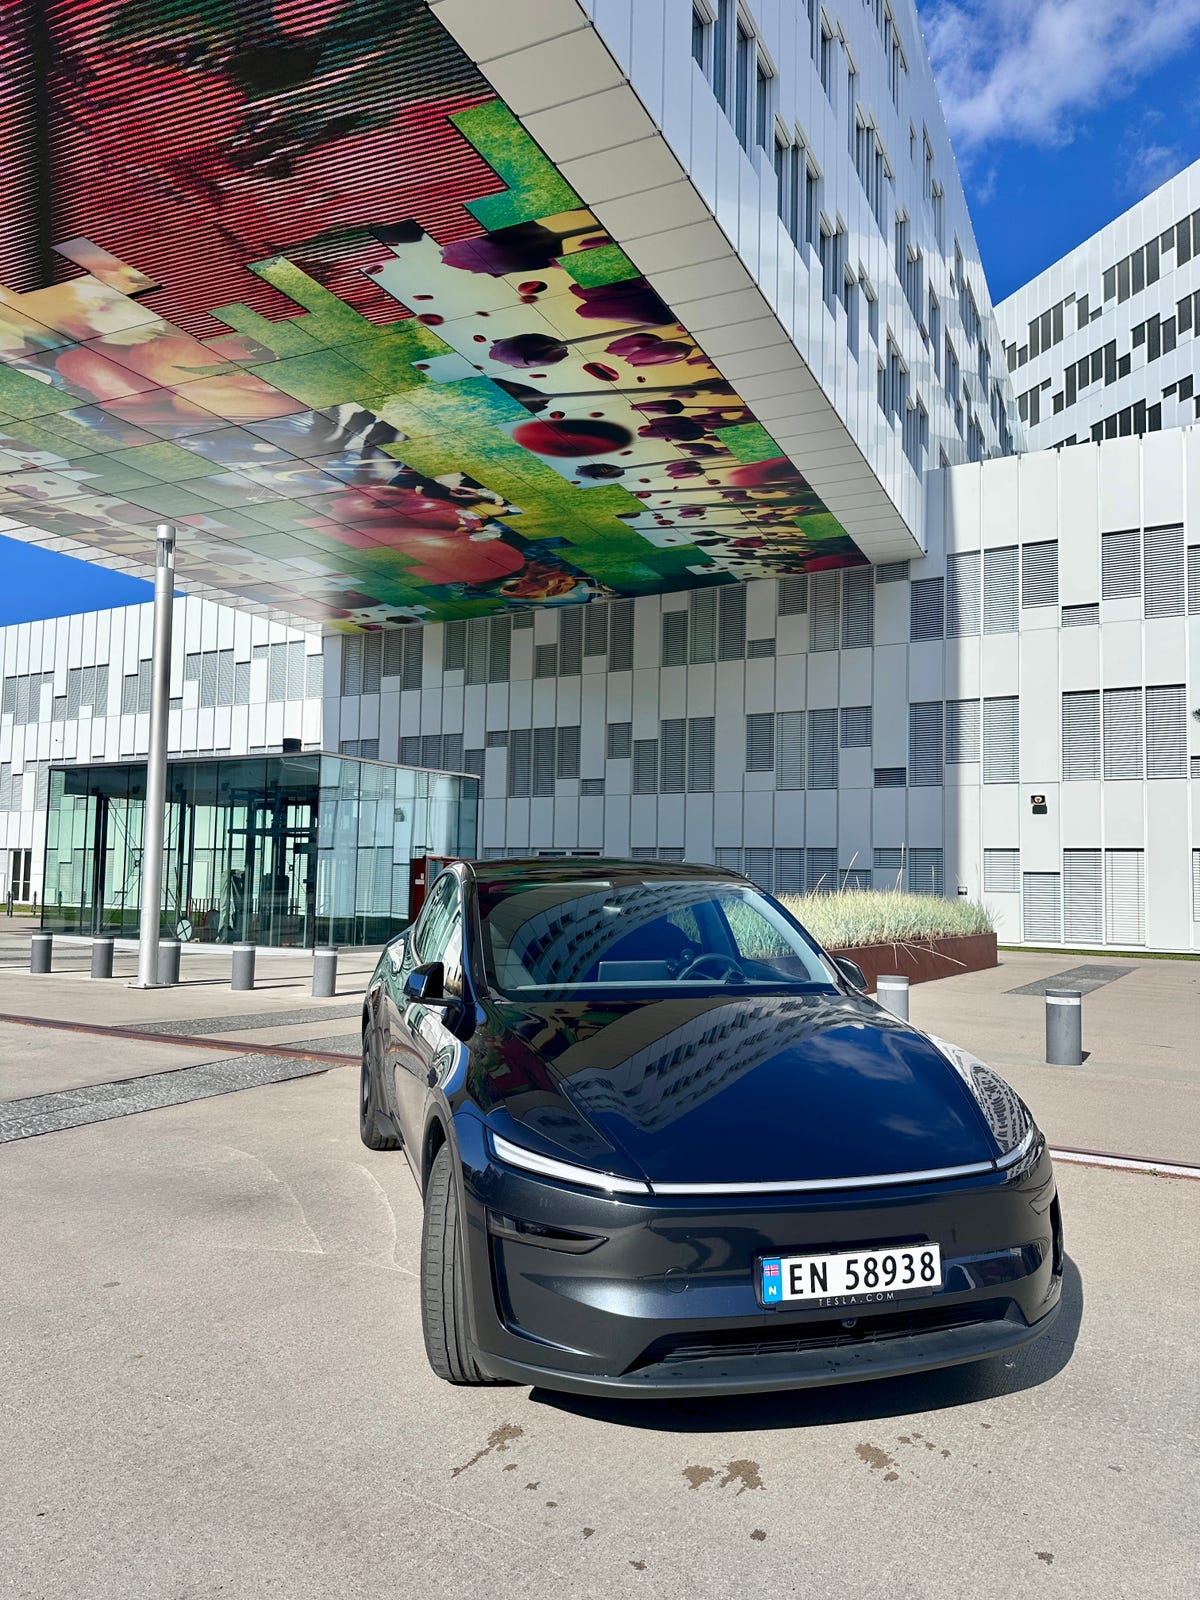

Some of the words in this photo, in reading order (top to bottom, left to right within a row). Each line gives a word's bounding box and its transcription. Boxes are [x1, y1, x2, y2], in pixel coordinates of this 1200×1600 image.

[790, 1262, 829, 1295] EN
[845, 1251, 936, 1291] 58938
[768, 1285, 777, 1296] N
[818, 1292, 895, 1307] TESLA.COM
